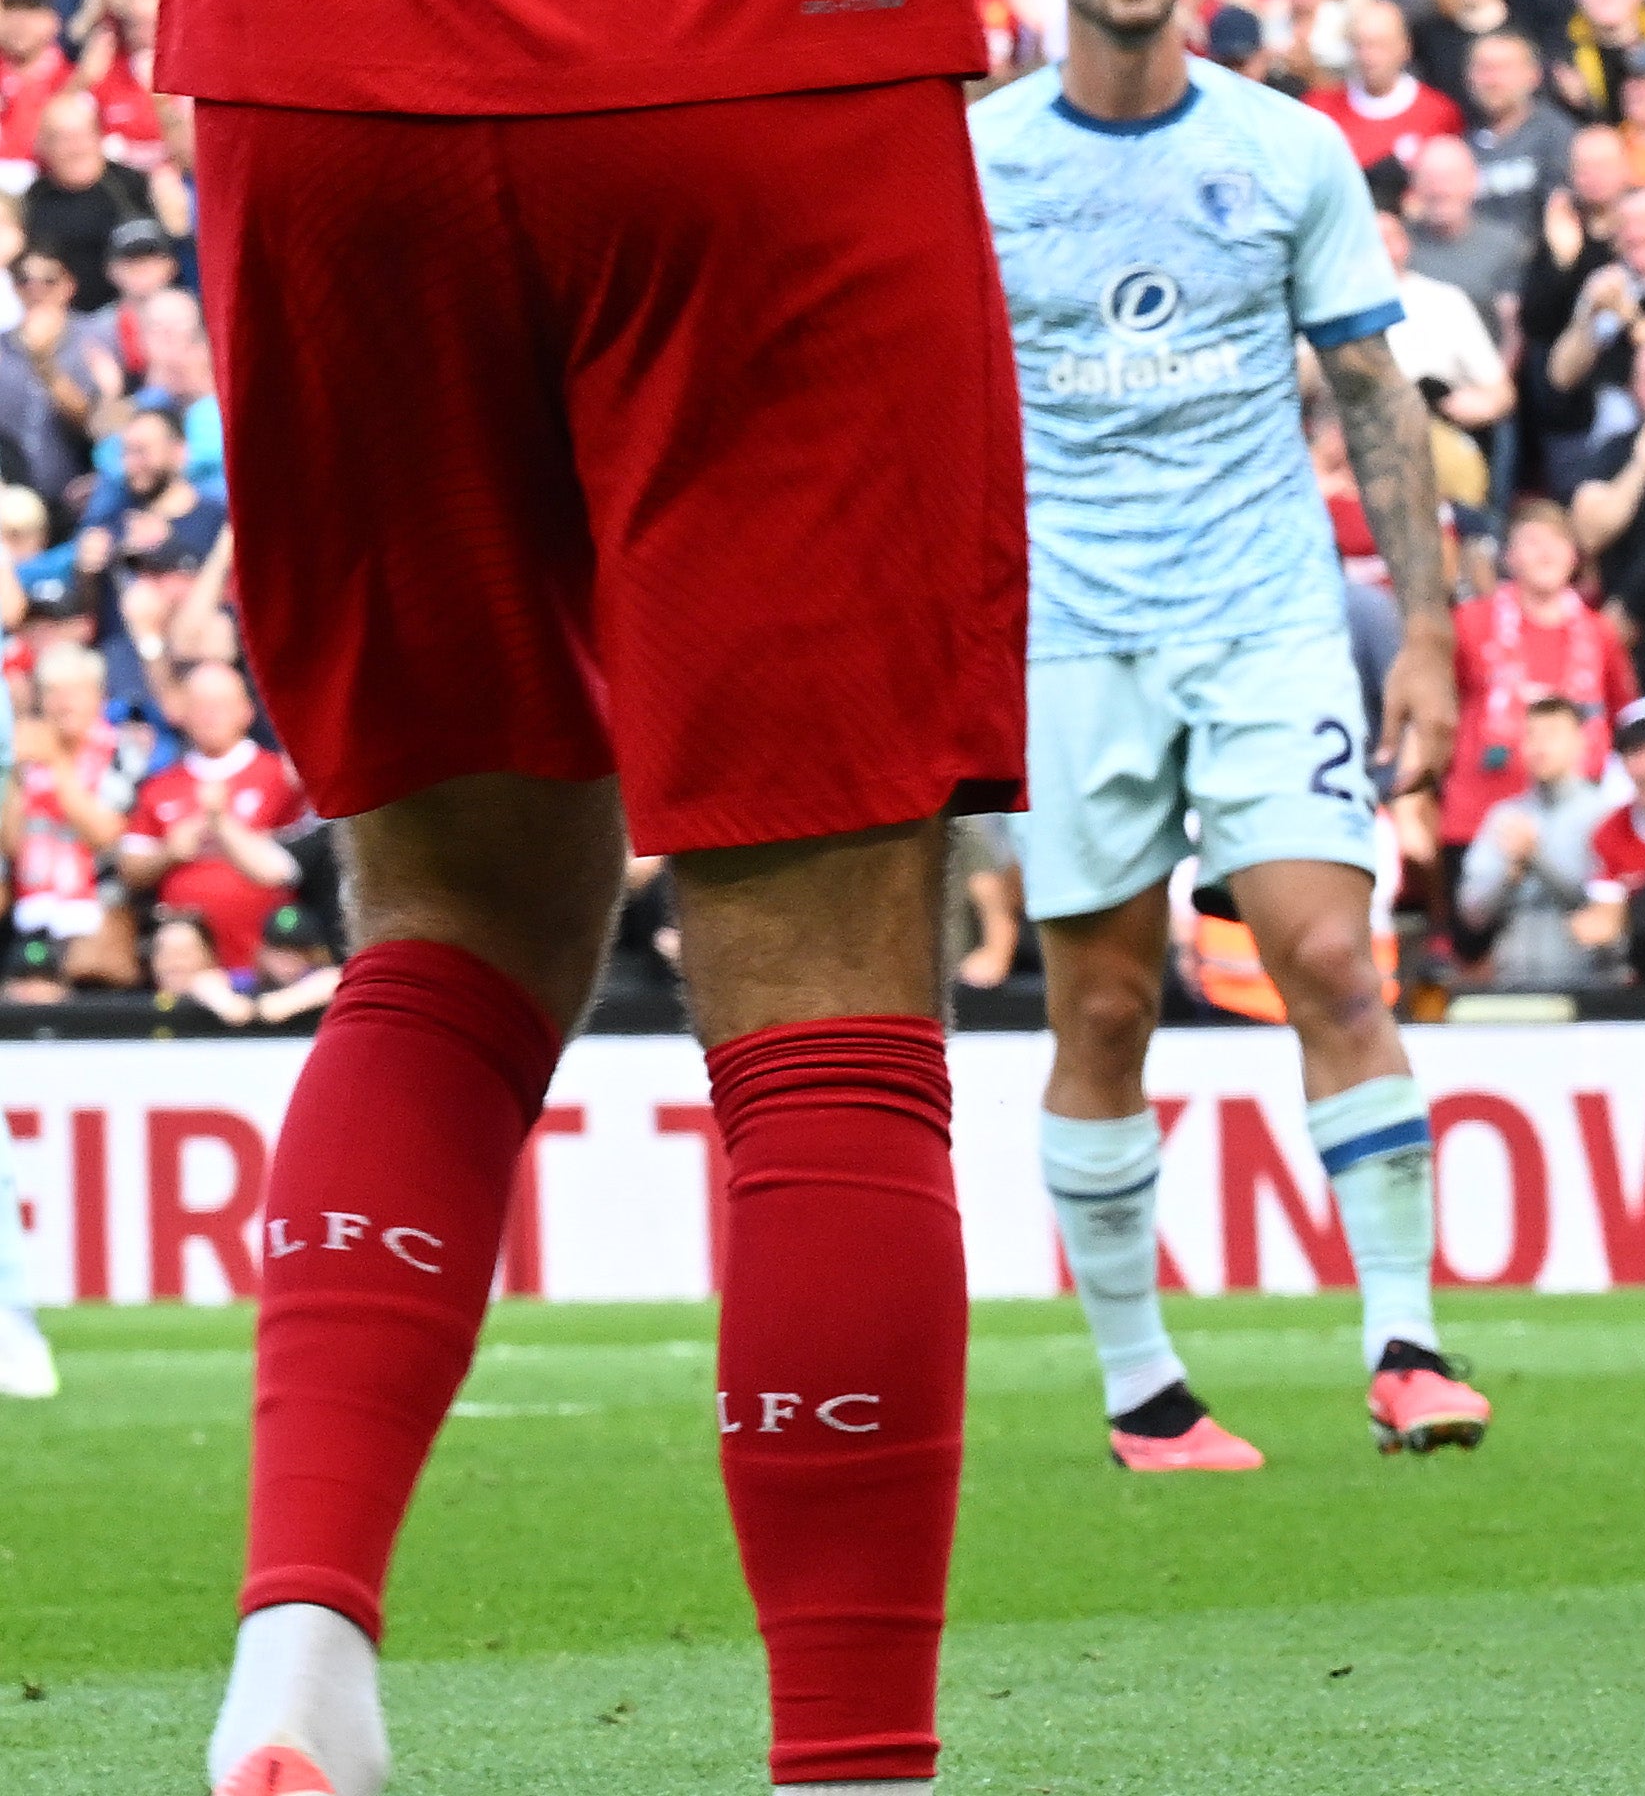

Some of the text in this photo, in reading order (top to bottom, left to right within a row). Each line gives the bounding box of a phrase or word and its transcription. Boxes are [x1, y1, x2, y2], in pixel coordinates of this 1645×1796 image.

[1047, 342, 1240, 402] dafabet
[267, 1211, 443, 1274] LFC
[716, 1391, 880, 1433] LFC
